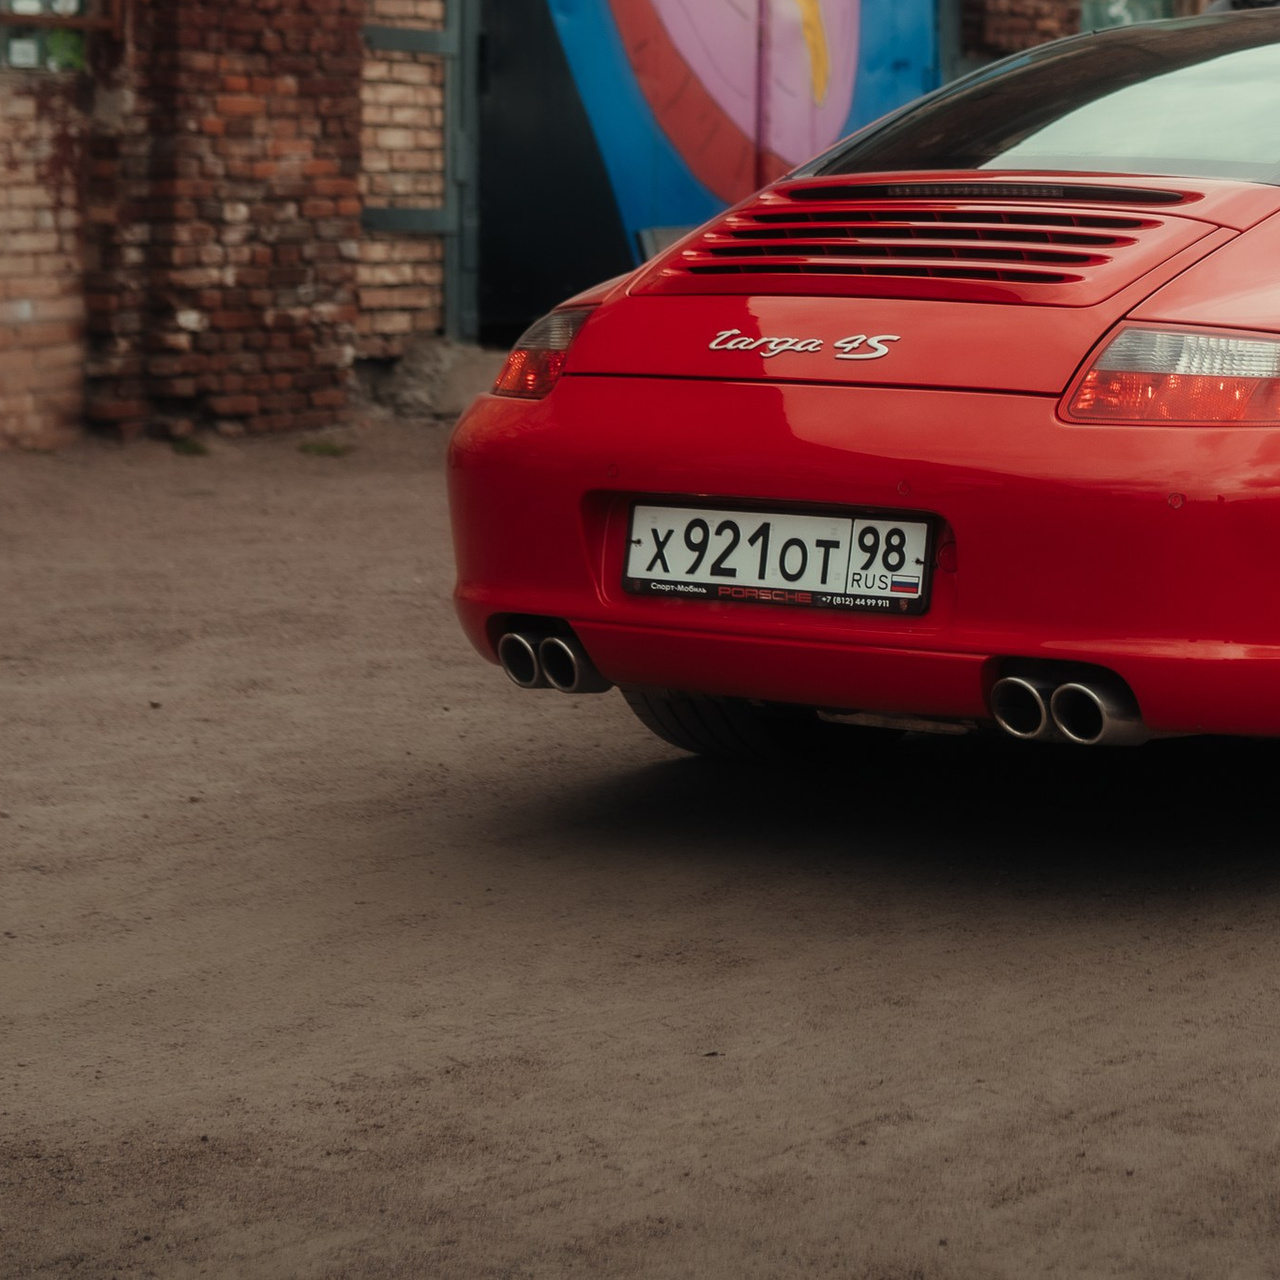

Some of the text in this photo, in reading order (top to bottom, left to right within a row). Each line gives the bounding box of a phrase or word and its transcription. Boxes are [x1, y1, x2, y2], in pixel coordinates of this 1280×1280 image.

[709, 329, 901, 360] targa 4S
[857, 525, 906, 572] 98
[850, 572, 889, 591] RUS
[718, 586, 812, 604] PORSCHE
[832, 596, 854, 607] (812)
[877, 600, 890, 608] 911
